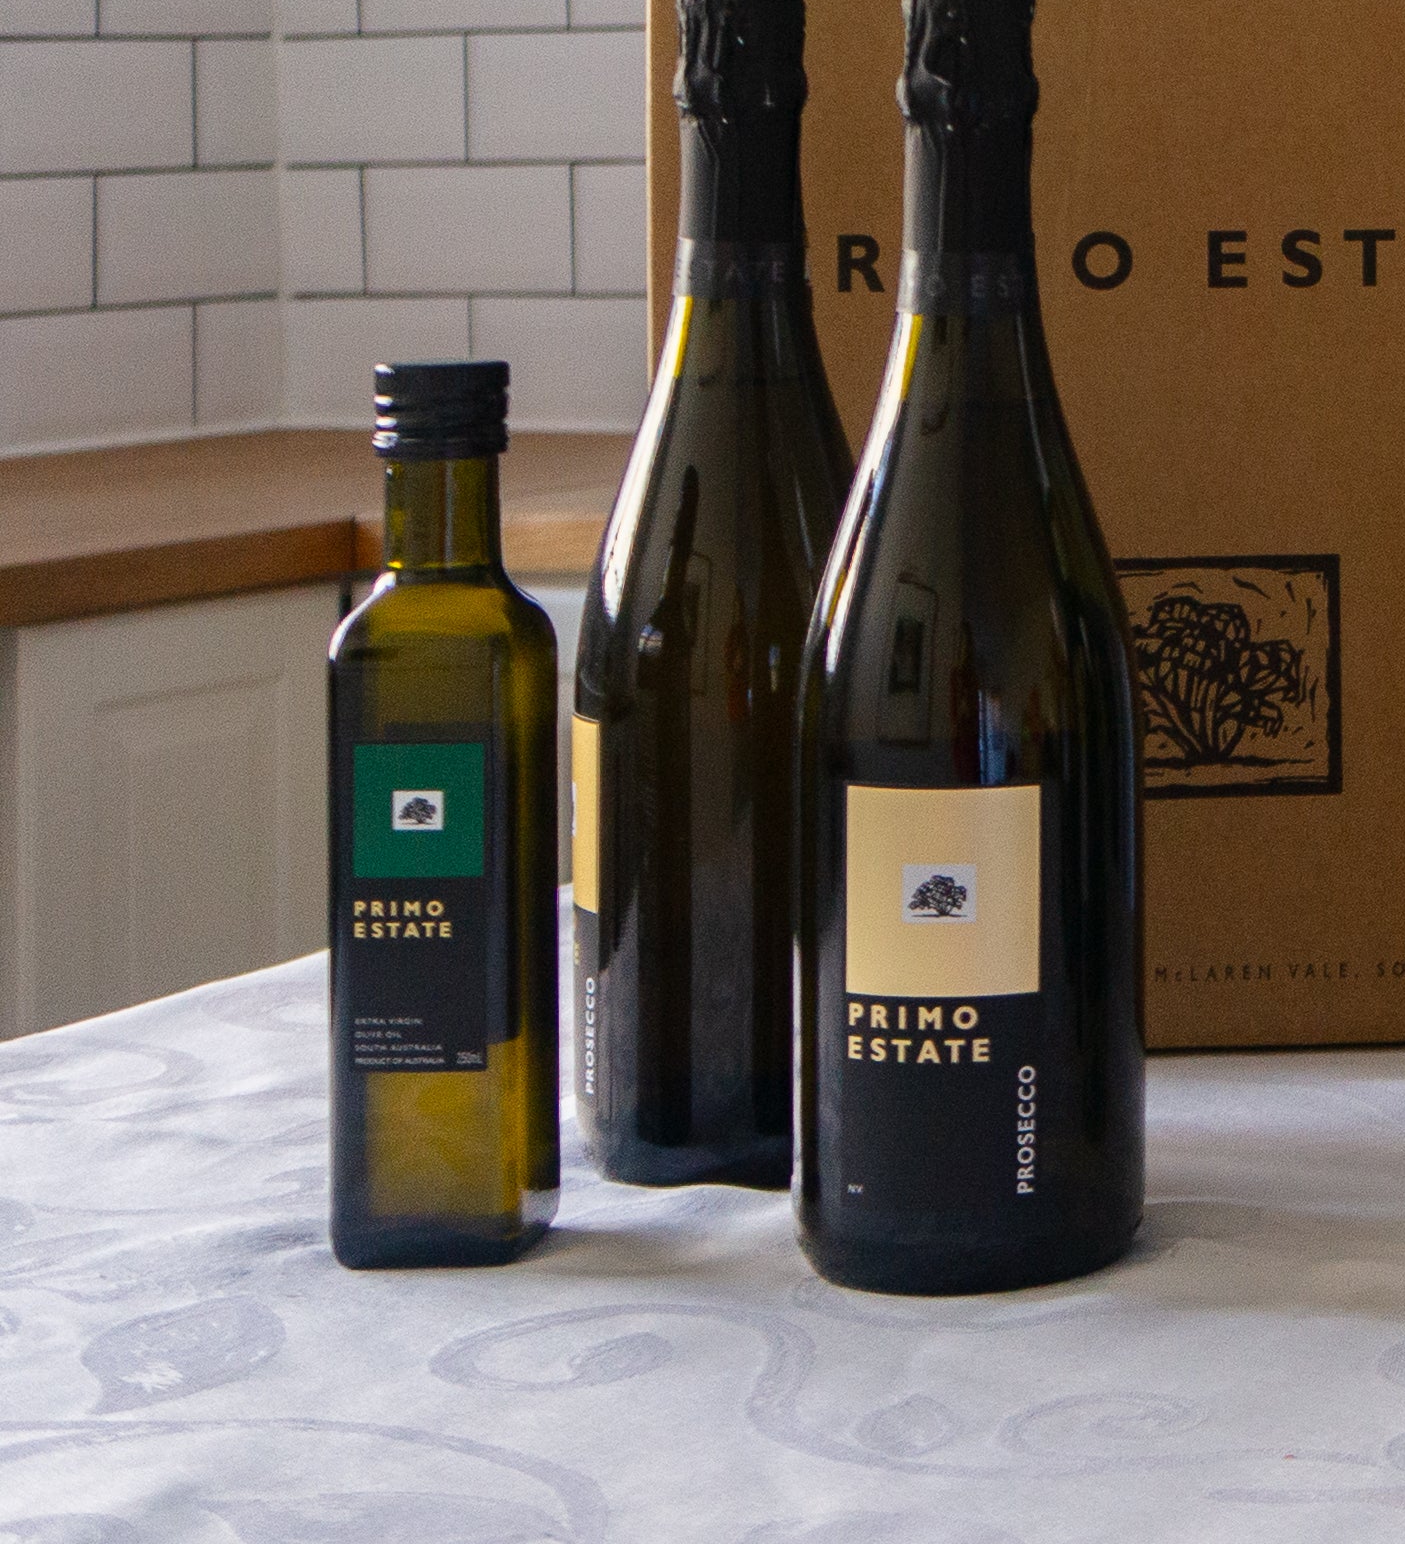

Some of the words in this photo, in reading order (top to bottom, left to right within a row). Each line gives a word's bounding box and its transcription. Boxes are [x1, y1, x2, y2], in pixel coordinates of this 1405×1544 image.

[352, 900, 445, 918] PRIMO
[352, 920, 453, 939] ESTATE
[1153, 965, 1273, 983] McLAREN
[847, 1002, 979, 1031] PRIMO
[584, 976, 596, 1096] PROSECCO
[846, 1035, 991, 1064] ESTATE
[1016, 1064, 1037, 1195] PROSECCO
